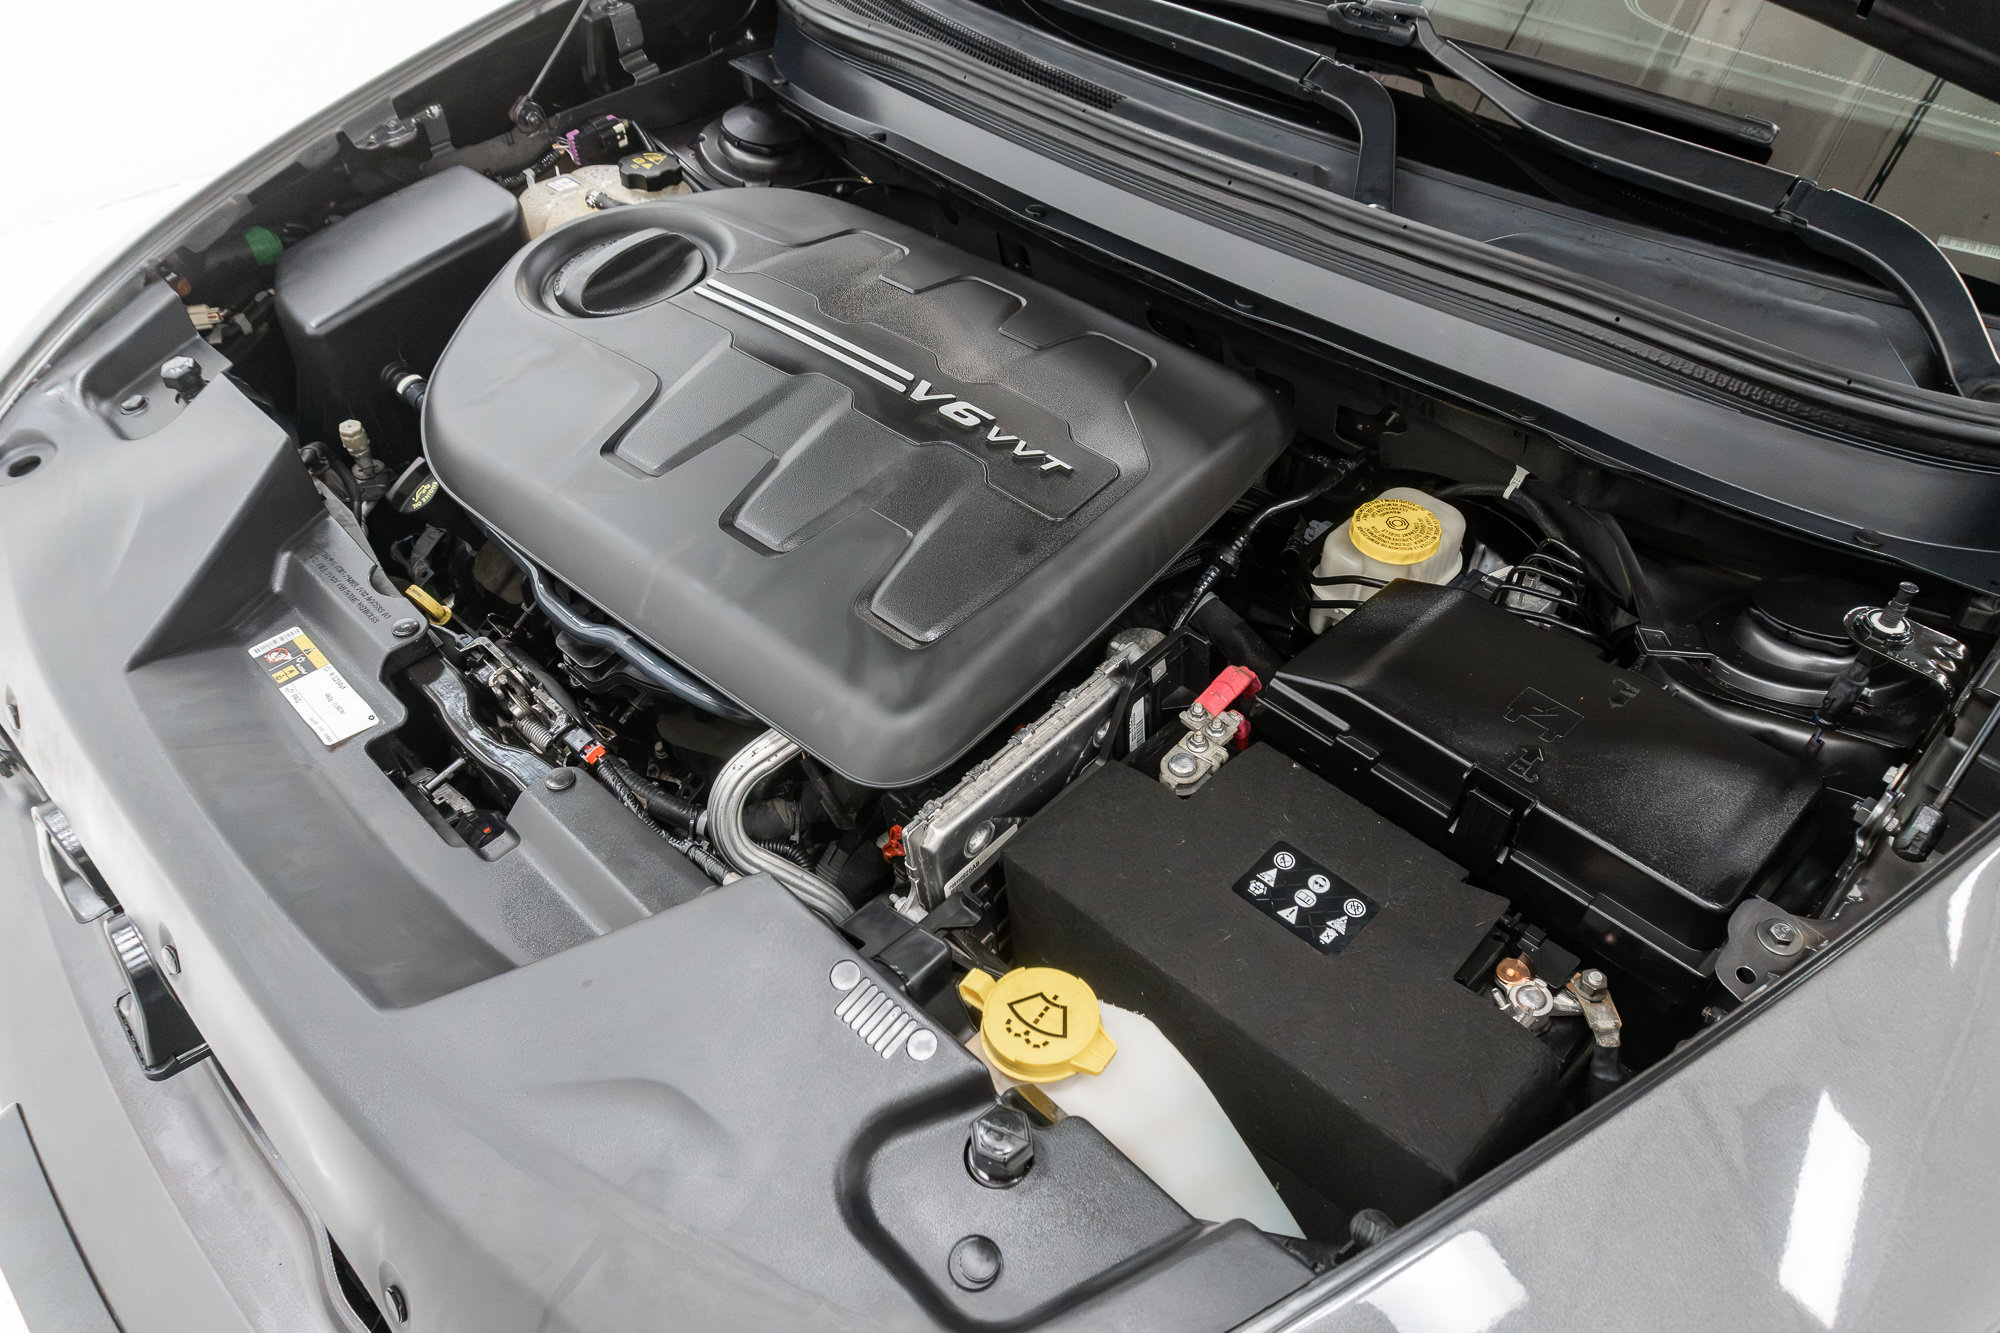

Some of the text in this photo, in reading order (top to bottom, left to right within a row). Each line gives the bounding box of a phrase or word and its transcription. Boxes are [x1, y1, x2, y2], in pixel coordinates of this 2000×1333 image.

[909, 379, 1073, 472] V6 VVT
[421, 481, 439, 503] ENGINE
